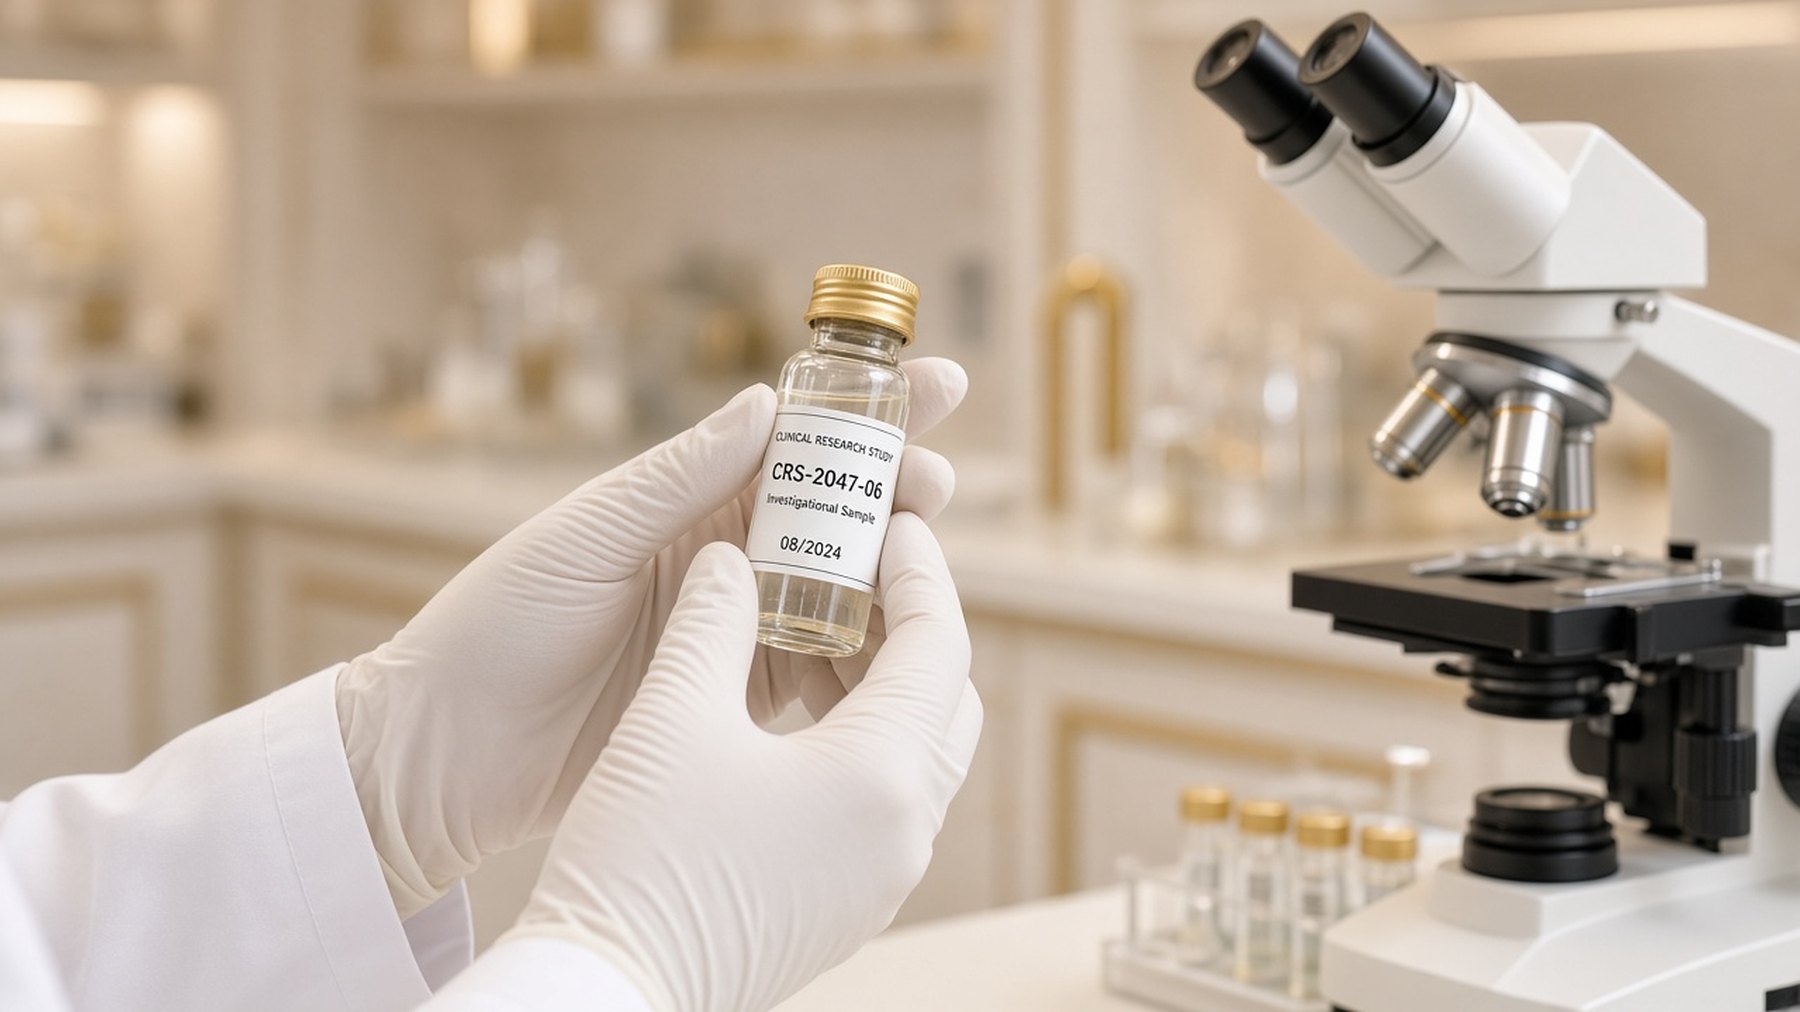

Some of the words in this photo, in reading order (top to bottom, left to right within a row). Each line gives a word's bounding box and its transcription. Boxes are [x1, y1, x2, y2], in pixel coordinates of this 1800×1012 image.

[775, 431, 812, 444] CLINICAL
[815, 435, 866, 455] RESEARCH
[868, 446, 894, 463] STUDY
[772, 462, 883, 499] CRS-2047-06
[767, 493, 839, 514] Investigational
[840, 505, 876, 525] Sample
[780, 535, 842, 560] 08/2024
